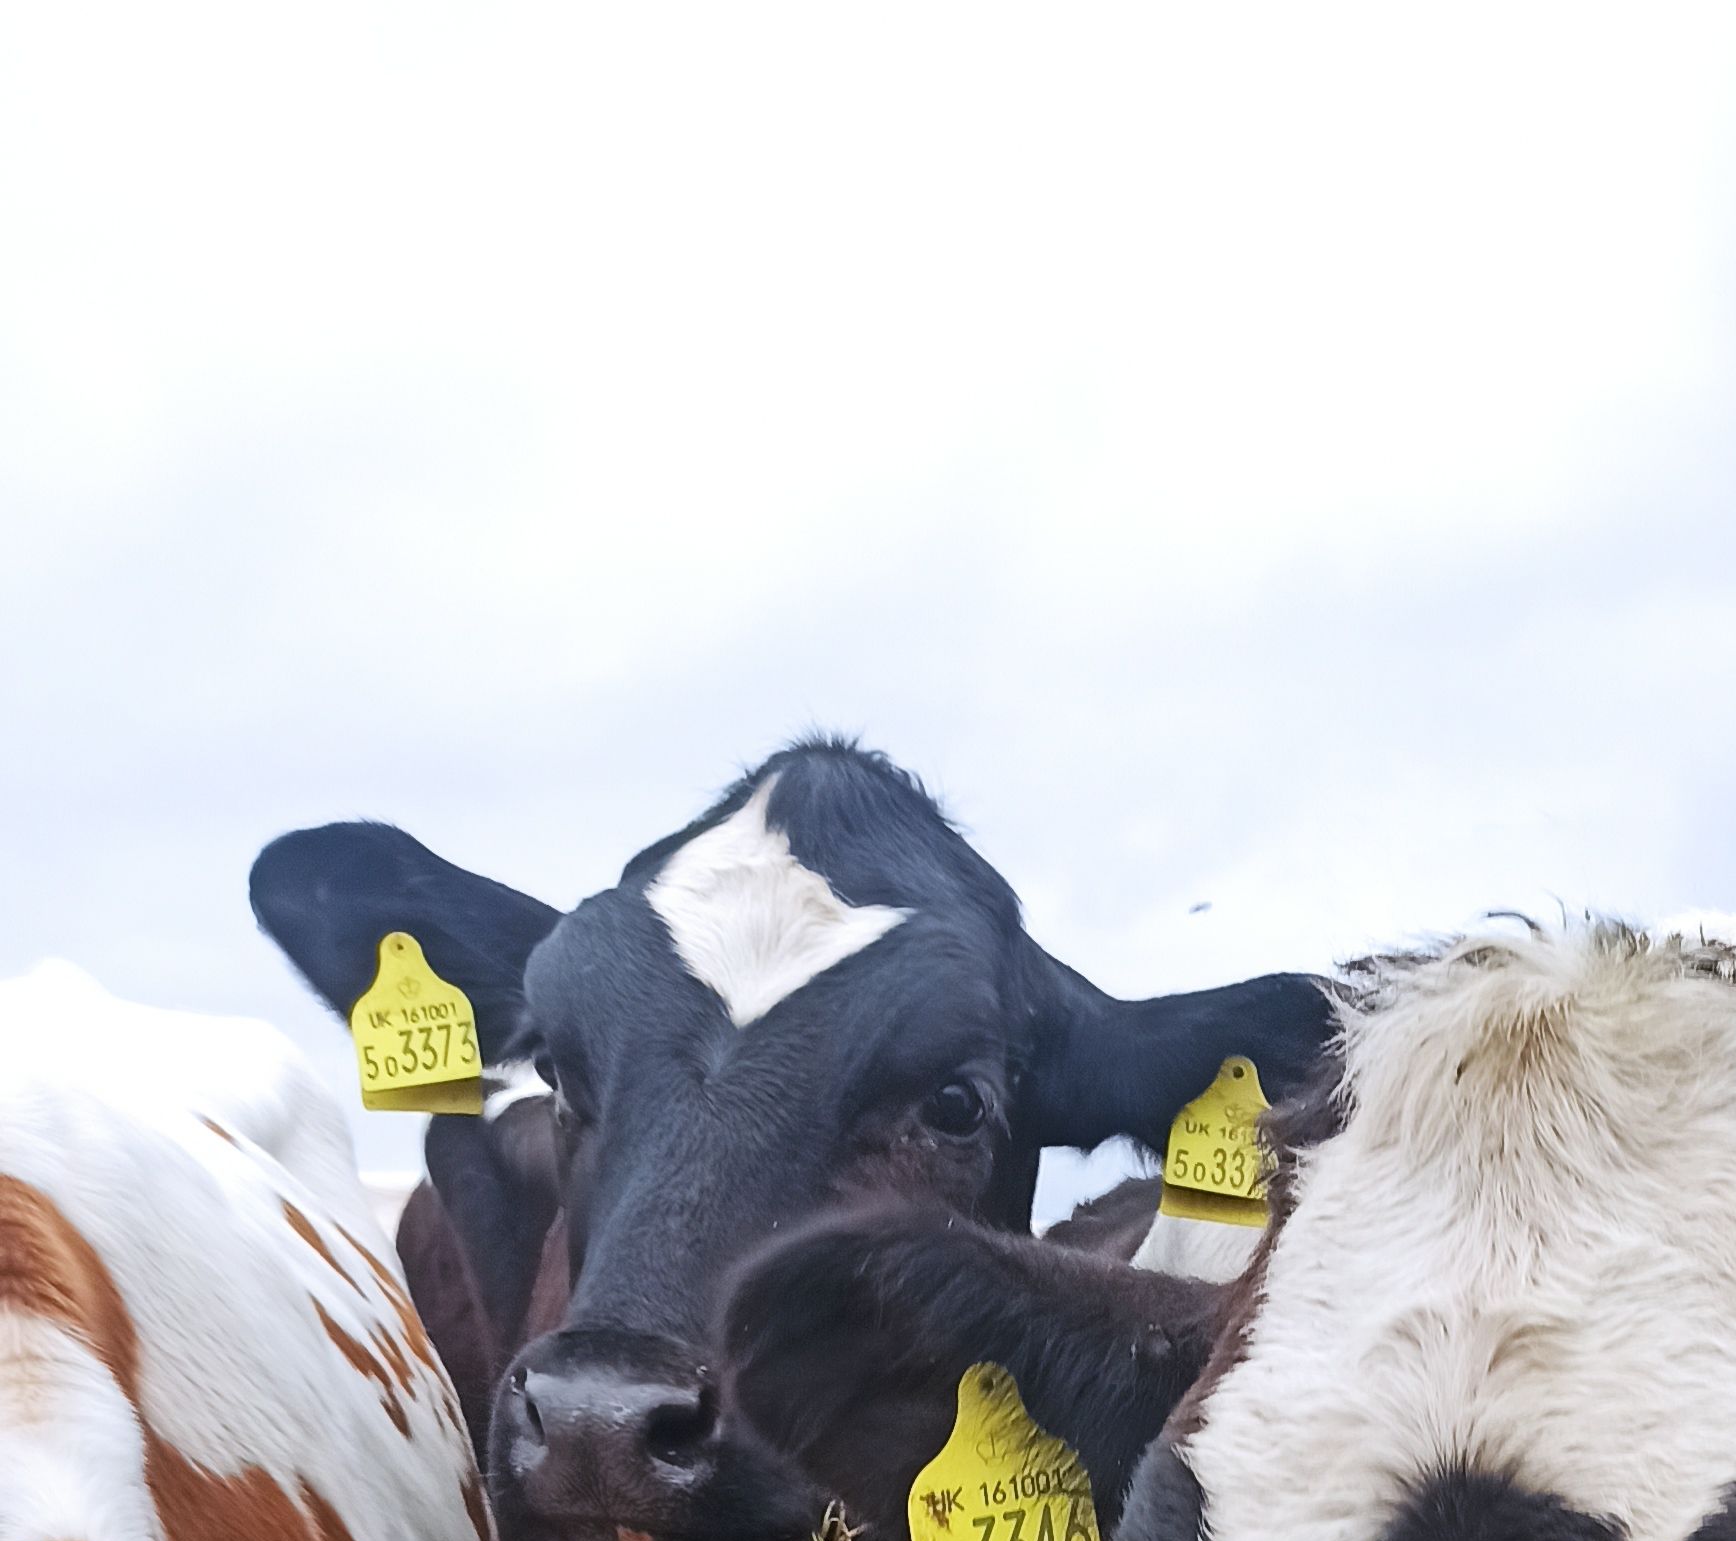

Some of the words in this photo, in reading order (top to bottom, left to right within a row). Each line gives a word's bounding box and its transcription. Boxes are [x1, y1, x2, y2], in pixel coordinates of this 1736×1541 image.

[369, 1011, 394, 1029] UK
[401, 1002, 457, 1024] 161001
[1184, 1120, 1210, 1137] UK
[1172, 1148, 1258, 1190] 5033
[979, 1466, 1072, 1507] 161001
